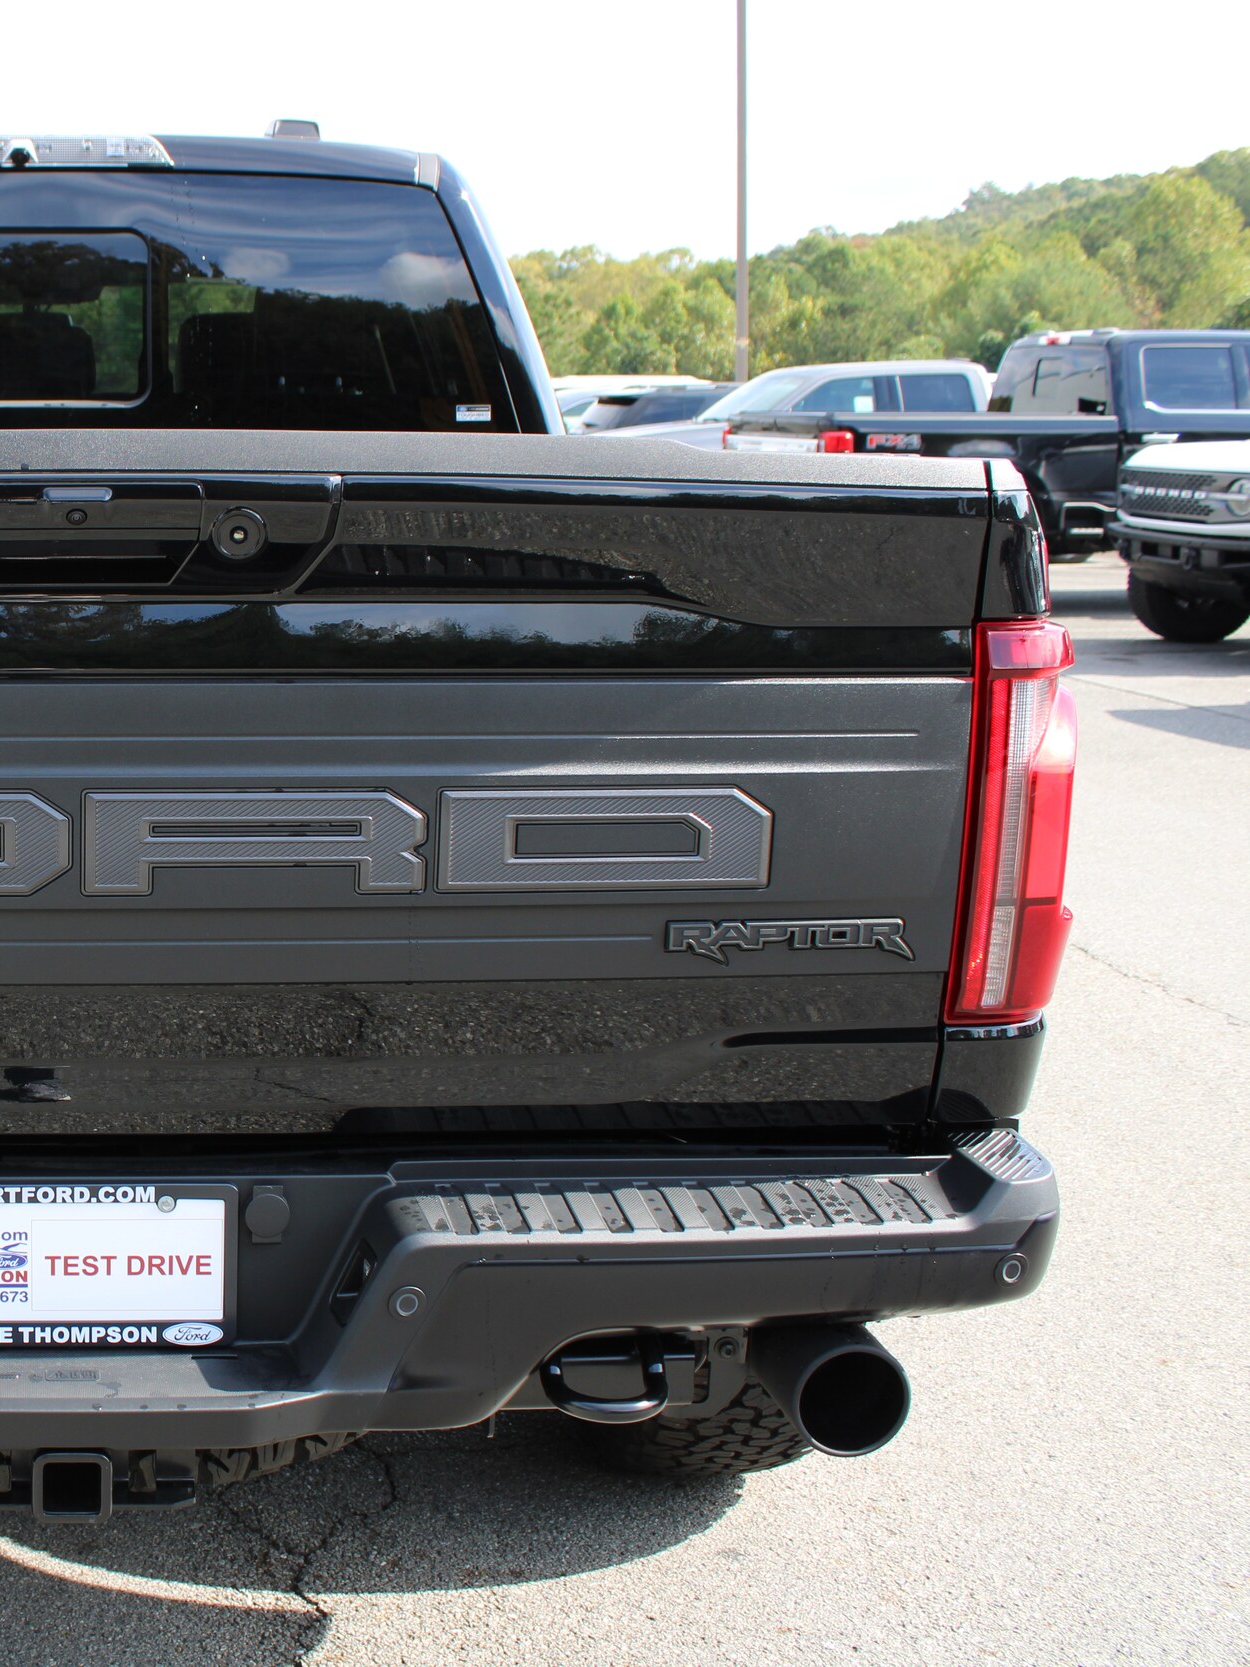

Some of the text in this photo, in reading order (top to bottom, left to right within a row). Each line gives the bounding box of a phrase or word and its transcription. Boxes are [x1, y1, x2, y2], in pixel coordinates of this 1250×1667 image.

[664, 917, 915, 966] RAPTOR
[45, 1254, 212, 1277] TEST DRIVE
[18, 1325, 157, 1344] THOMPSON
[173, 1326, 211, 1342] Ford
